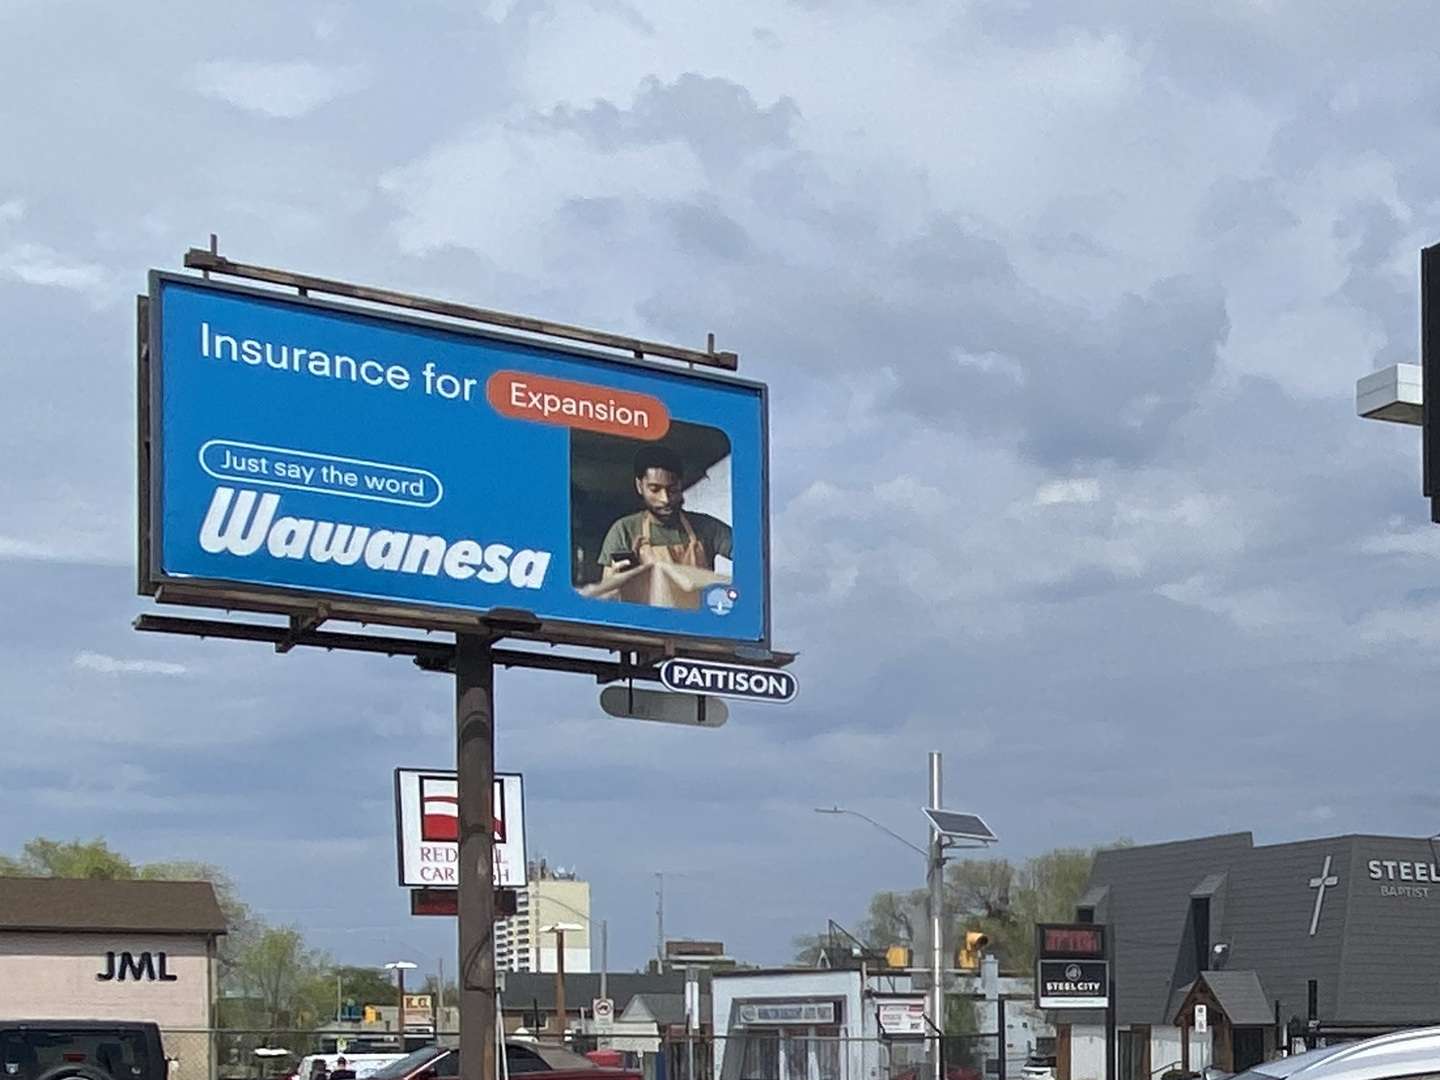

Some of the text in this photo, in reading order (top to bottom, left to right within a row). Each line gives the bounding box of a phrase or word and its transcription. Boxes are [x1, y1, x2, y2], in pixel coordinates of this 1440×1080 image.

[200, 323, 649, 428] Insurance for Expansion
[220, 450, 425, 497] Just say the word
[199, 487, 552, 590] Wawanesa
[673, 665, 787, 696] PATTISON
[420, 846, 458, 864] RED
[420, 866, 455, 882] CAR
[96, 951, 178, 982] JML
